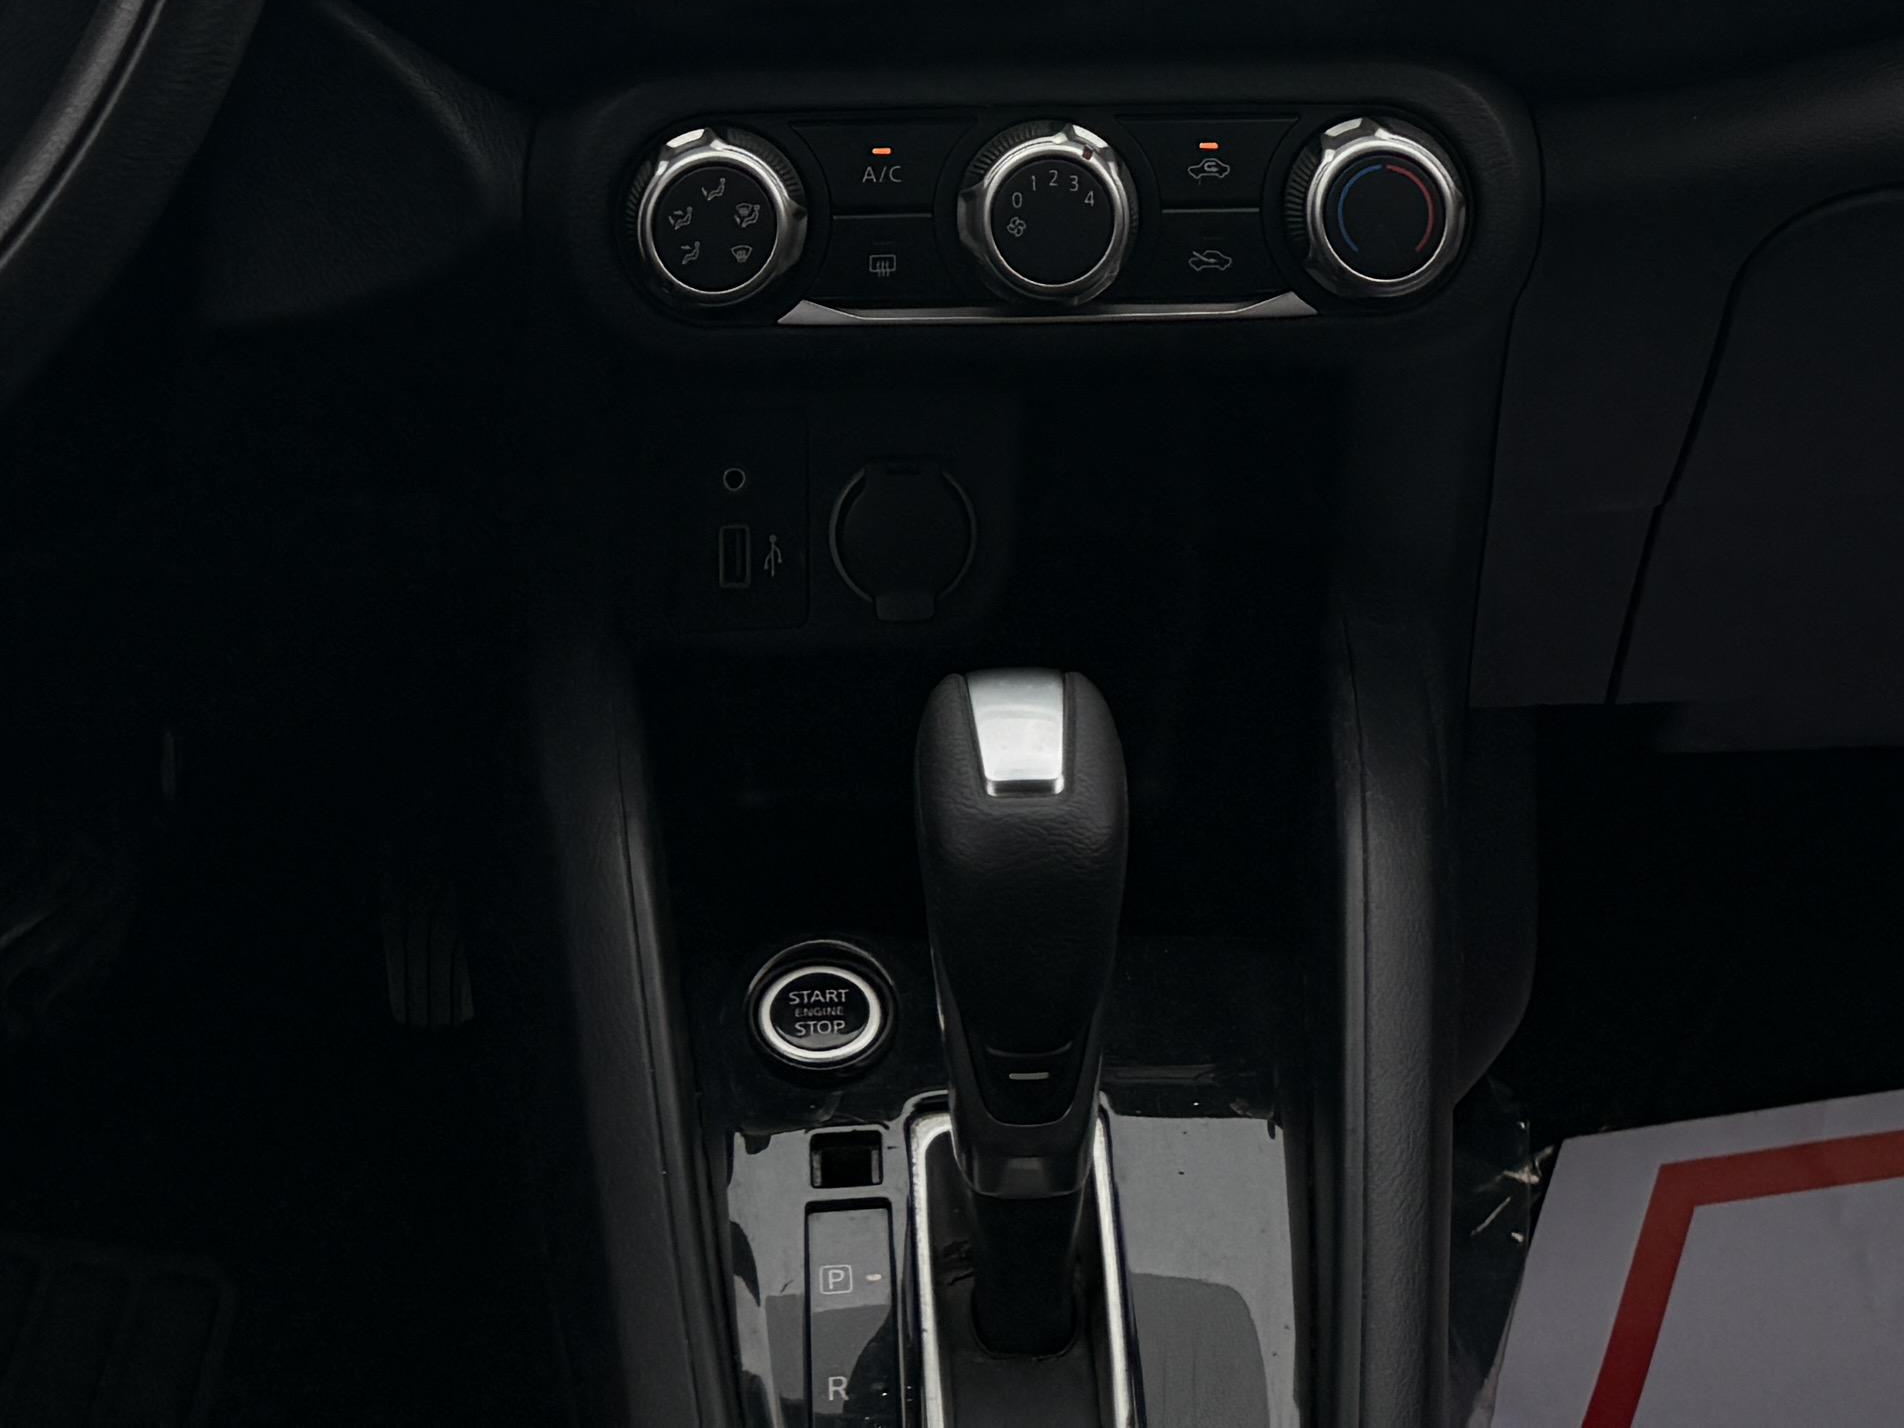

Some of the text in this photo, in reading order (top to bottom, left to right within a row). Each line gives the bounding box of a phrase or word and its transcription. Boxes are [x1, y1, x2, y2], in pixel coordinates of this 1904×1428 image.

[862, 165, 902, 183] A/C
[1011, 169, 1095, 209] 0 1 2 3 4
[788, 988, 849, 1005] START
[794, 1006, 845, 1018] ENGINE
[793, 1019, 848, 1037] STOP
[827, 1375, 849, 1401] R
